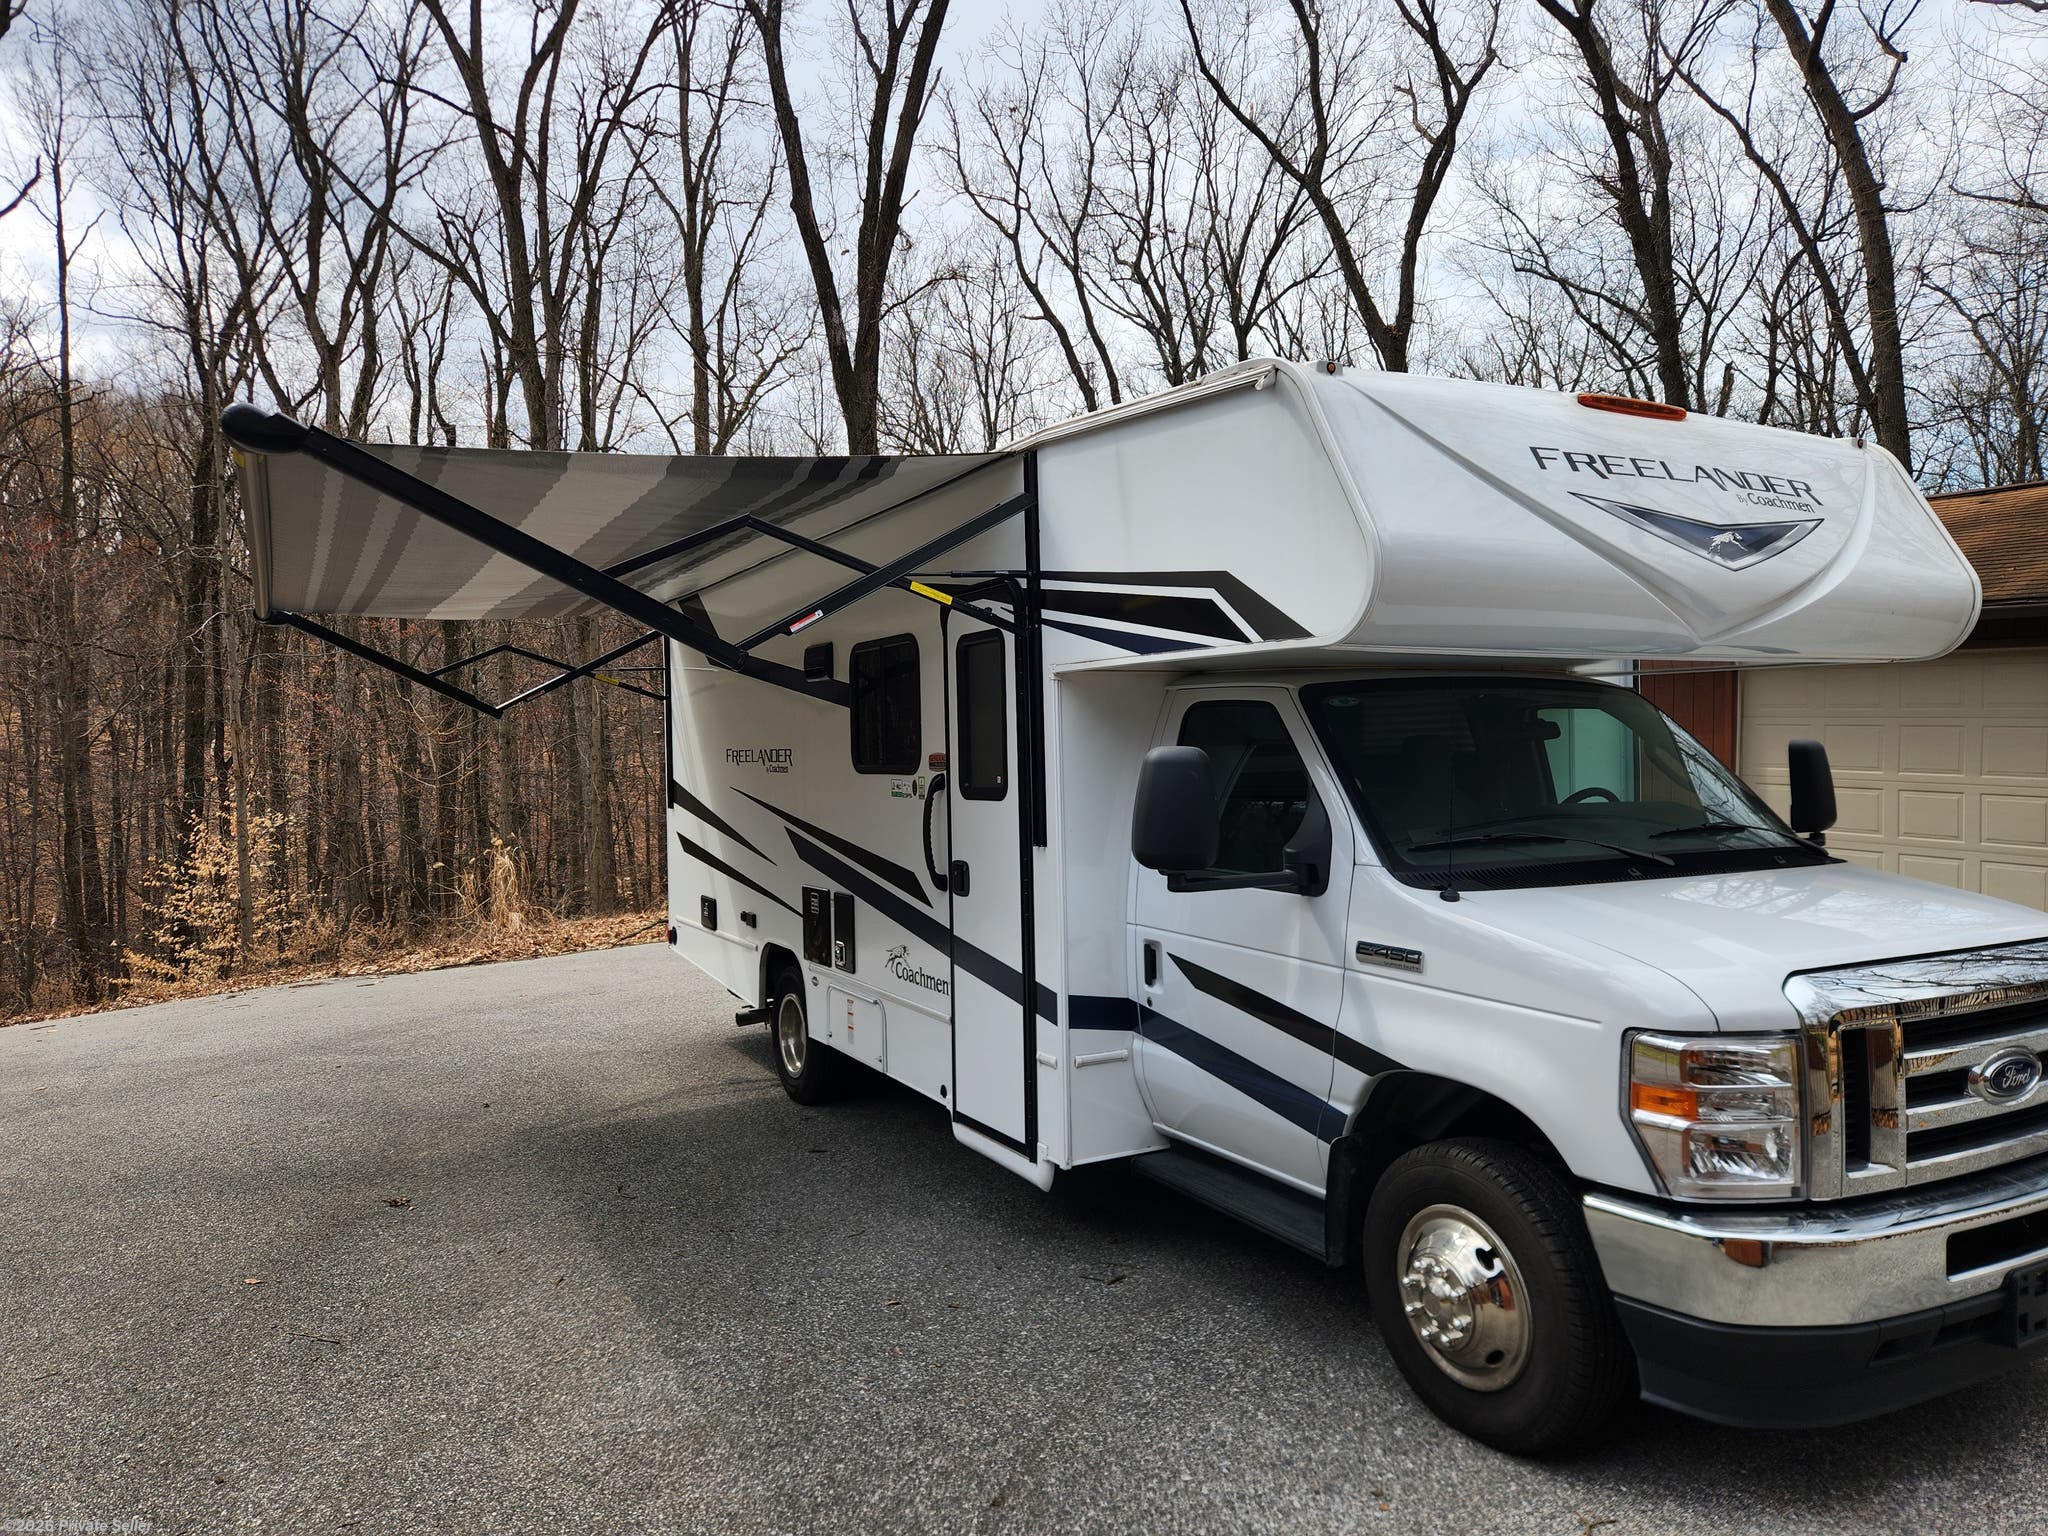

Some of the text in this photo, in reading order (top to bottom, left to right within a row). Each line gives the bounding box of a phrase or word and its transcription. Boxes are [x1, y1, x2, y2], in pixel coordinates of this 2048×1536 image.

[1529, 446, 1824, 506] FREELANDER
[1747, 492, 1816, 514] Coachmen
[726, 748, 793, 767] FREELANDER
[895, 961, 950, 996] Coachmen
[2002, 1064, 2031, 1089] Ford
